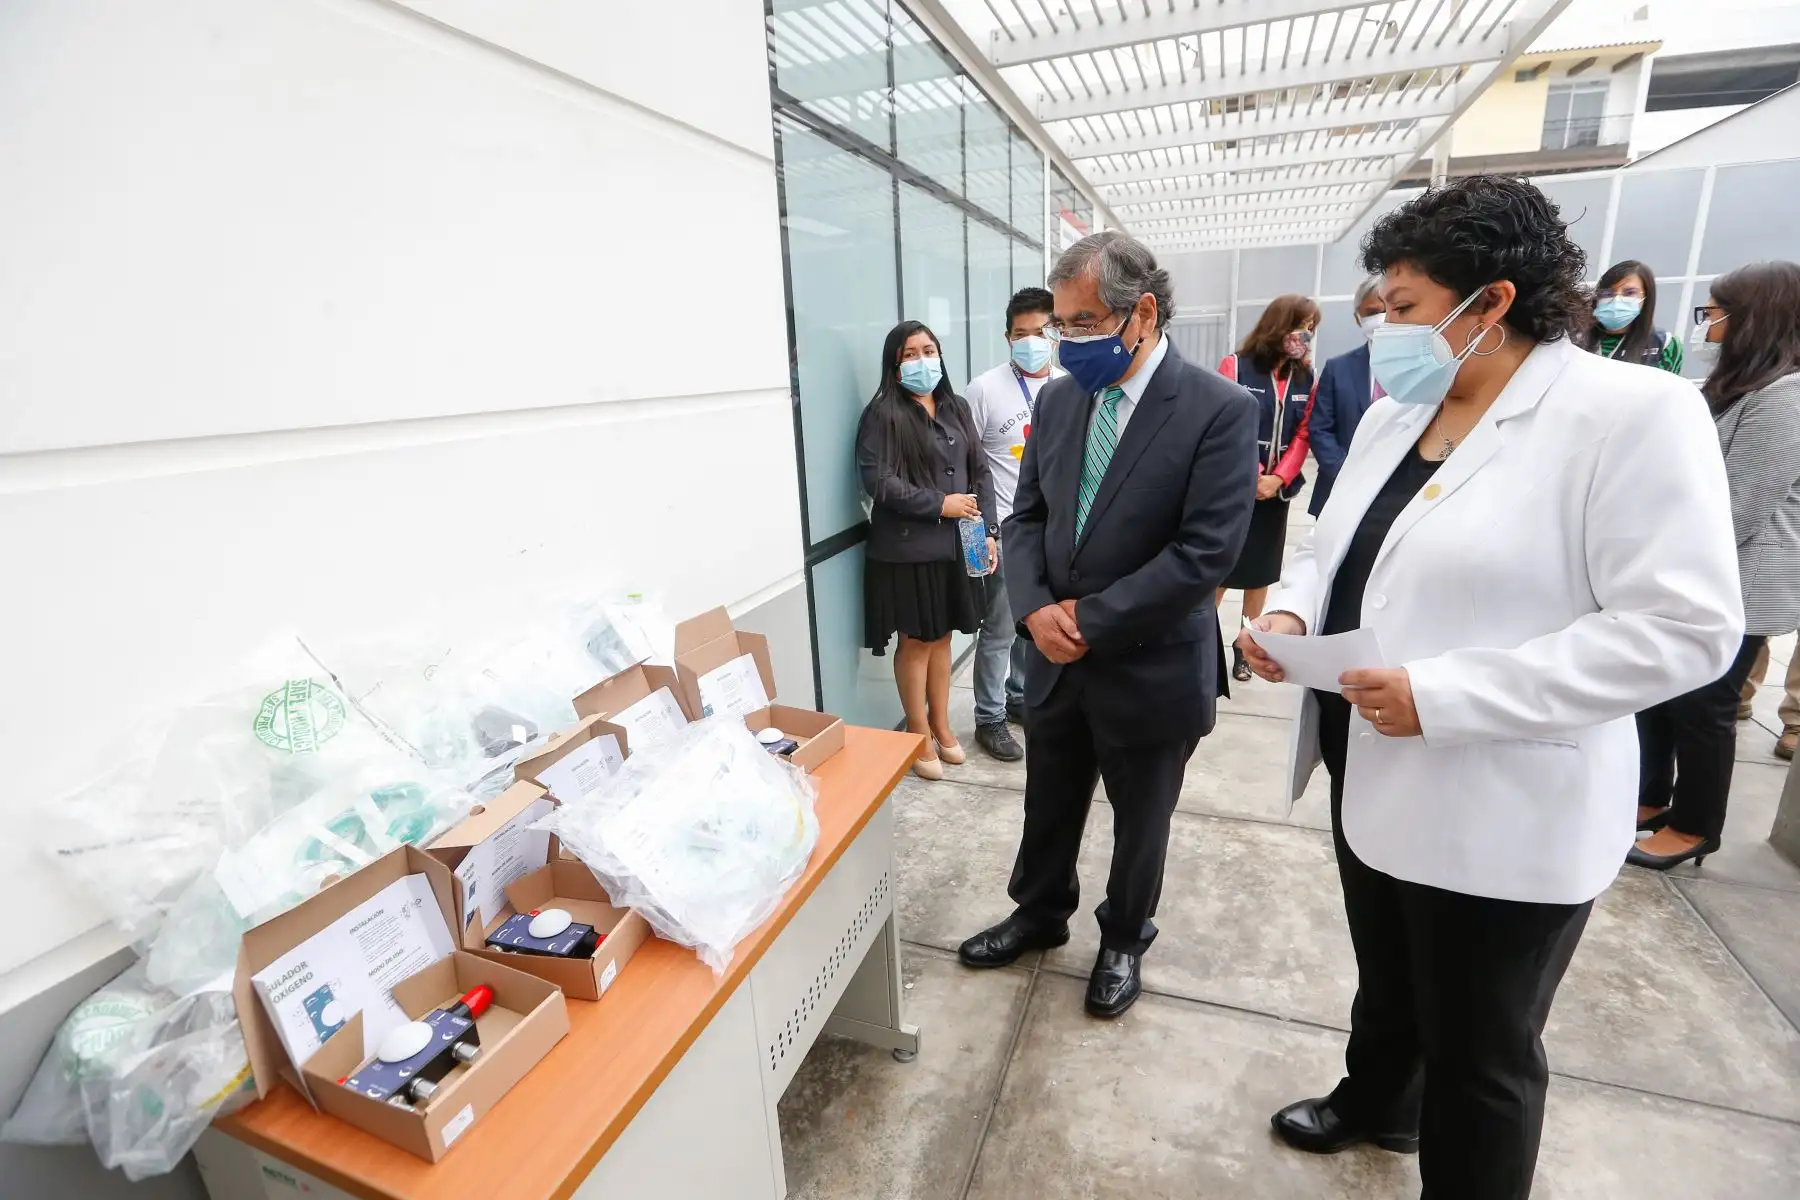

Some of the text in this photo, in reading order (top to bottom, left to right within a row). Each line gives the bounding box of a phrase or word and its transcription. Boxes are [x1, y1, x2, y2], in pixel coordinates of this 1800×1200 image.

[999, 410, 1030, 435] RED DE
[257, 695, 286, 746] SAFE PRODUCT
